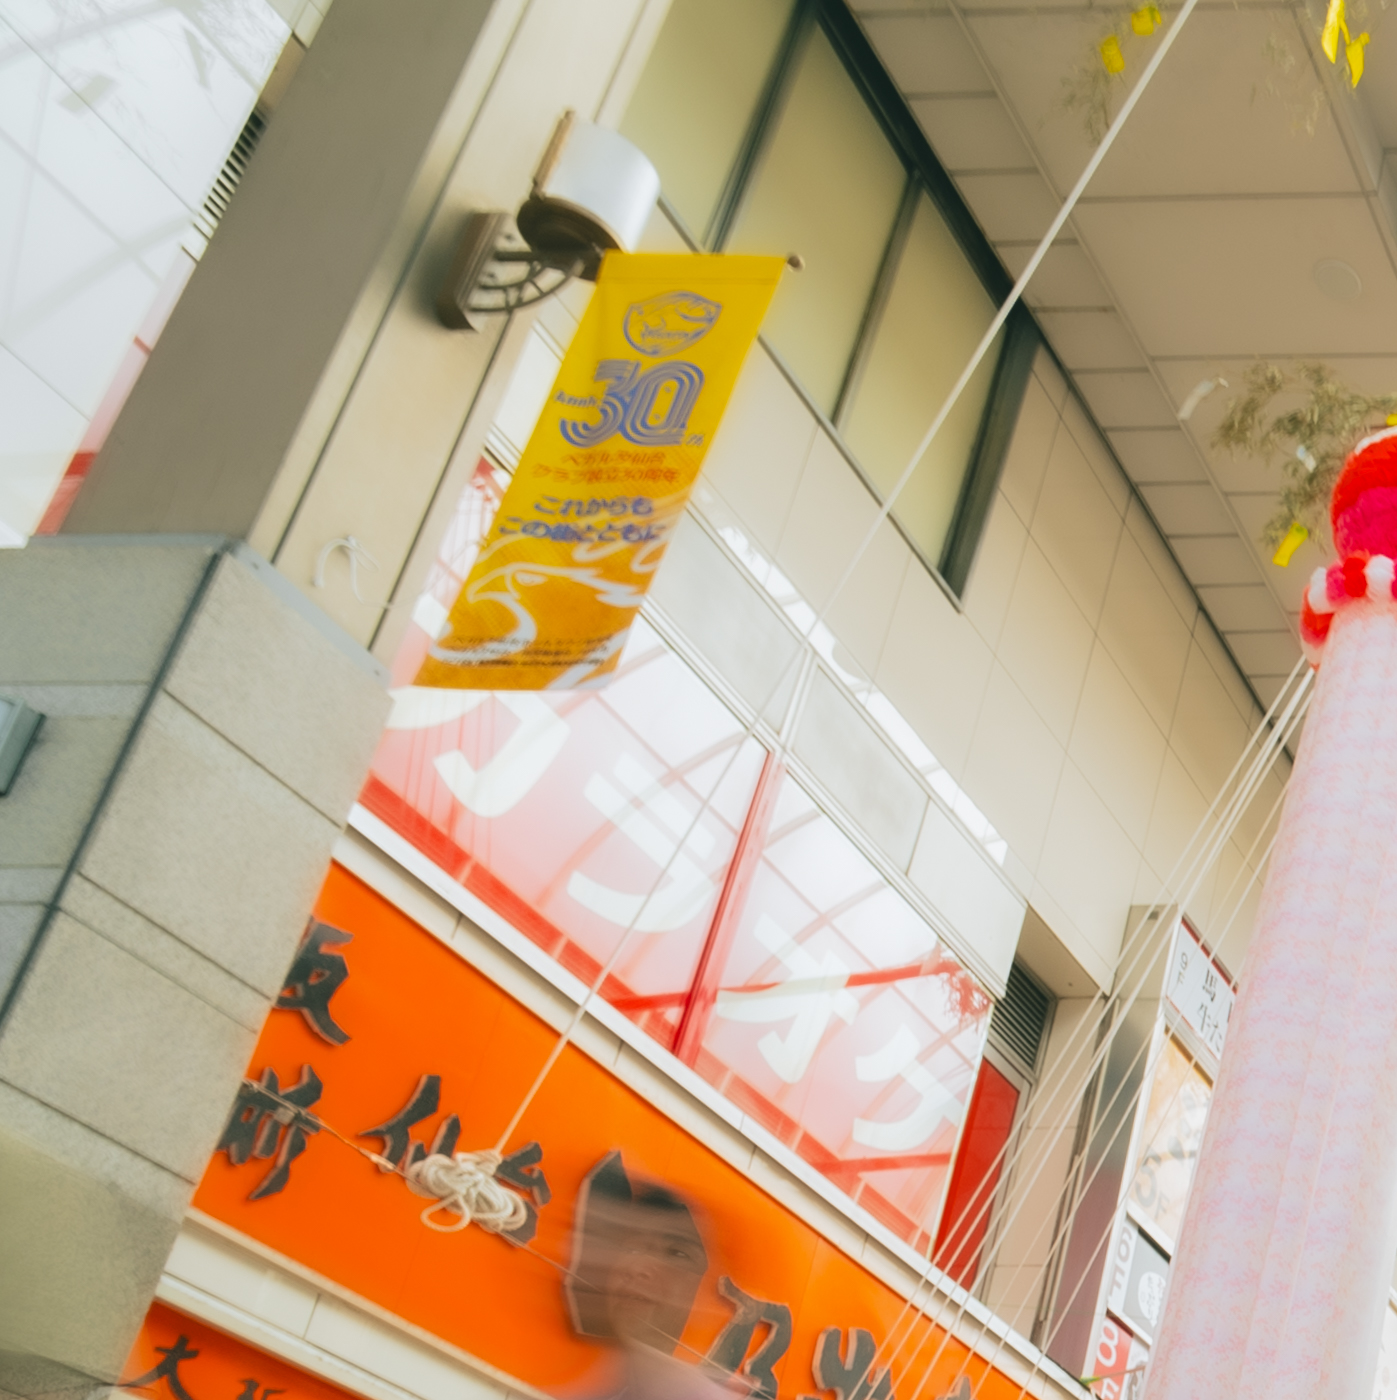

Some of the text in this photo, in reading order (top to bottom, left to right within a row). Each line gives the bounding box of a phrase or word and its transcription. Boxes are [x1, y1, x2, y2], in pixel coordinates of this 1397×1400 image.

[559, 359, 706, 449] 30
[533, 495, 654, 518] これからも
